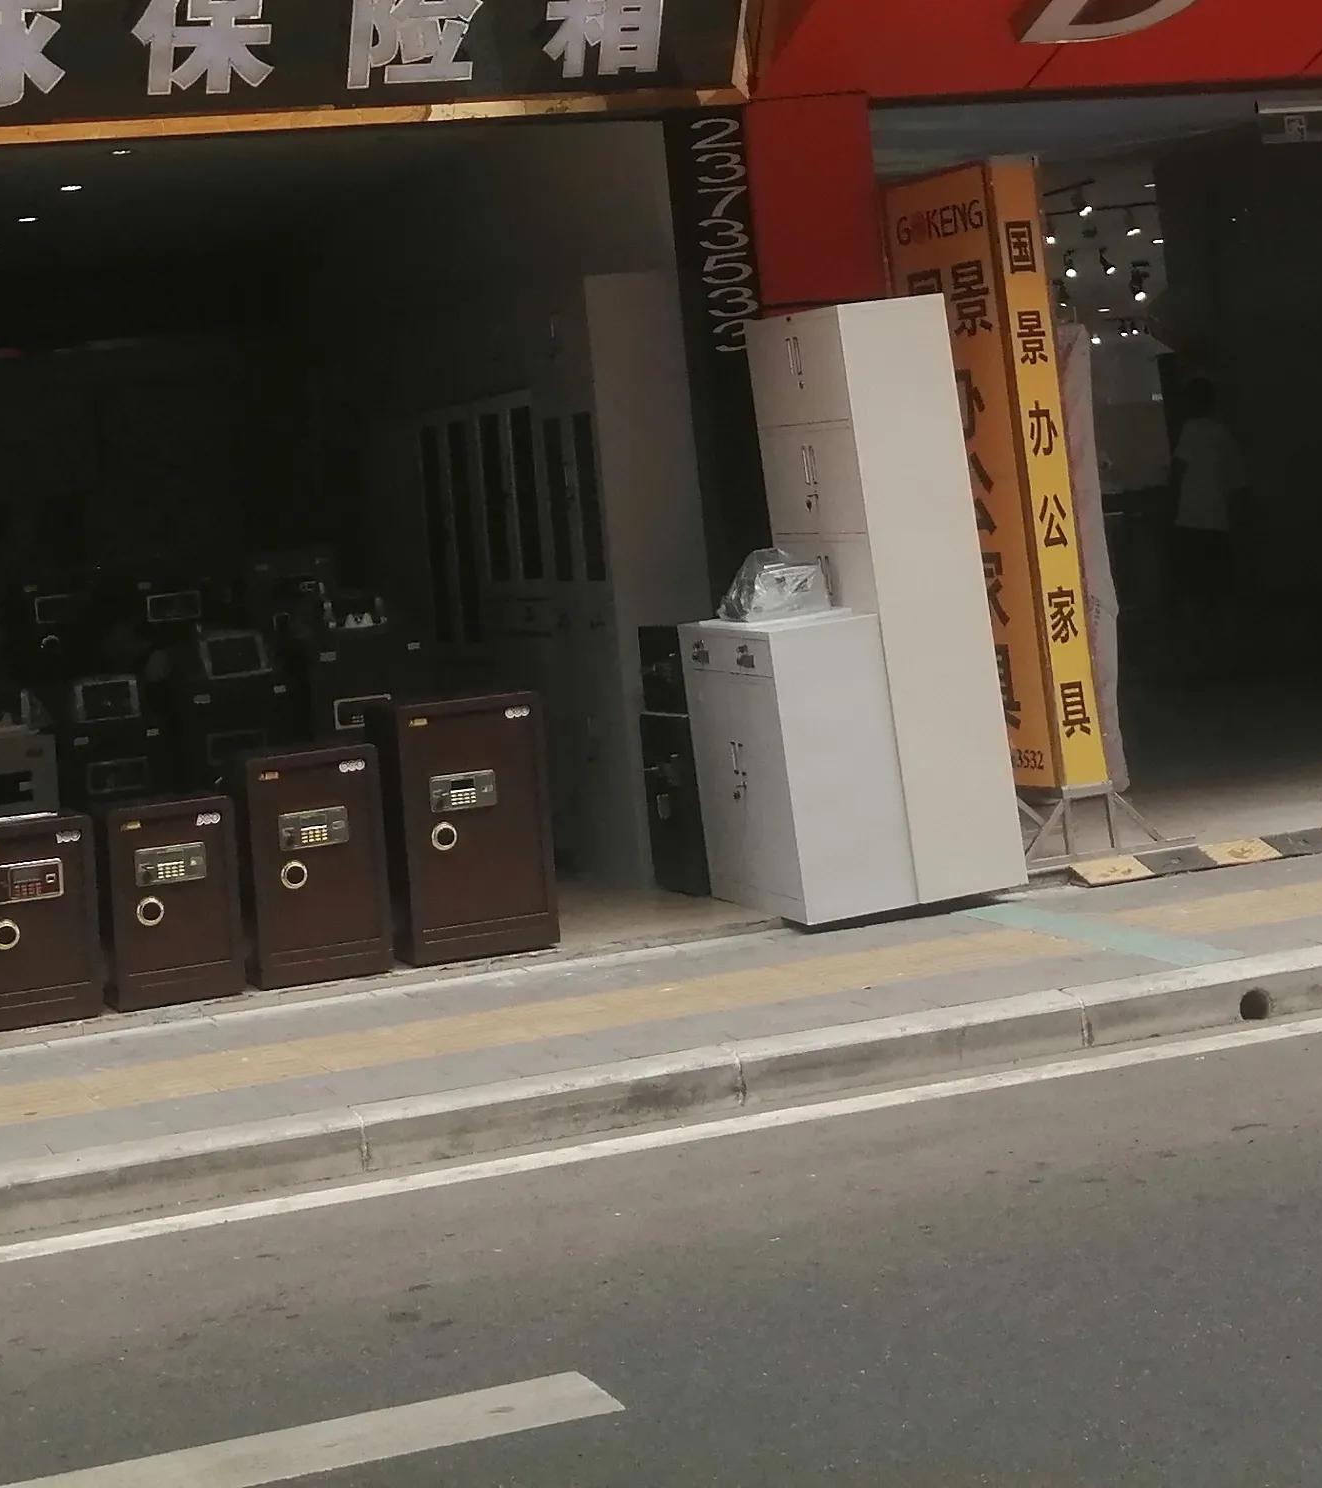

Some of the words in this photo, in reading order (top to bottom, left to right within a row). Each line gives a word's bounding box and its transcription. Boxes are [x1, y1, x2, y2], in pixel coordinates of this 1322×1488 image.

[1005, 220, 1092, 737] 国景办公家具
